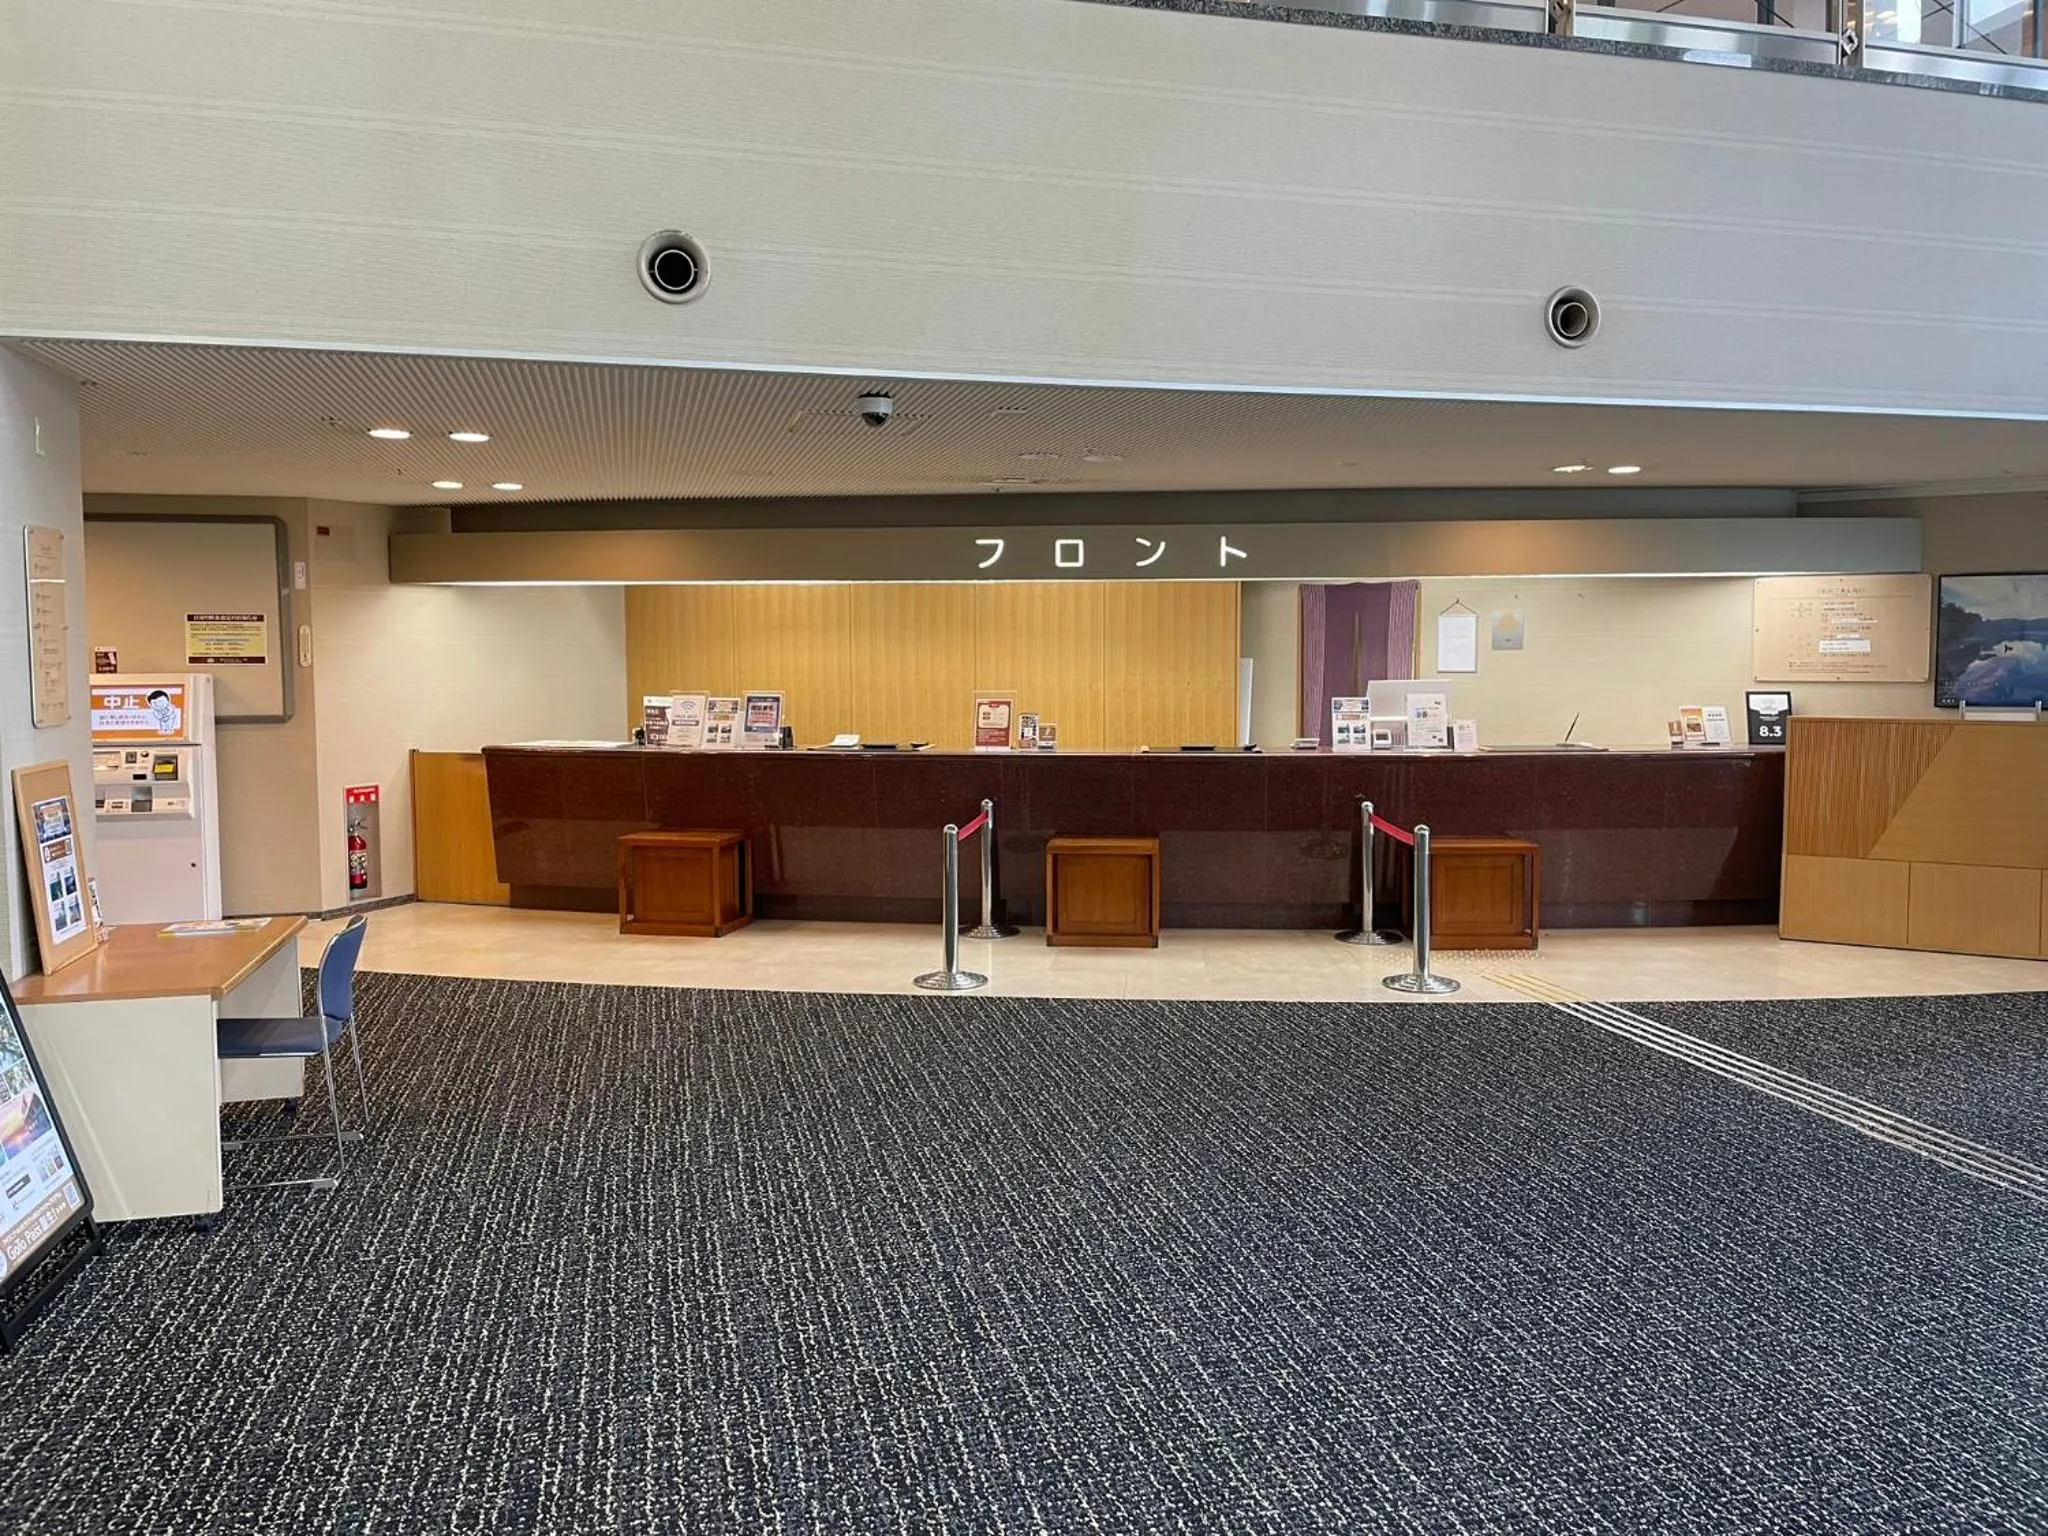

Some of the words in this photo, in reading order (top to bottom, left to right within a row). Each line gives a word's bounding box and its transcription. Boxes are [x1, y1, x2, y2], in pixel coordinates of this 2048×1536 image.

[975, 536, 1247, 569] フロント
[103, 695, 140, 709] 中止
[1759, 725, 1782, 737] 8.3
